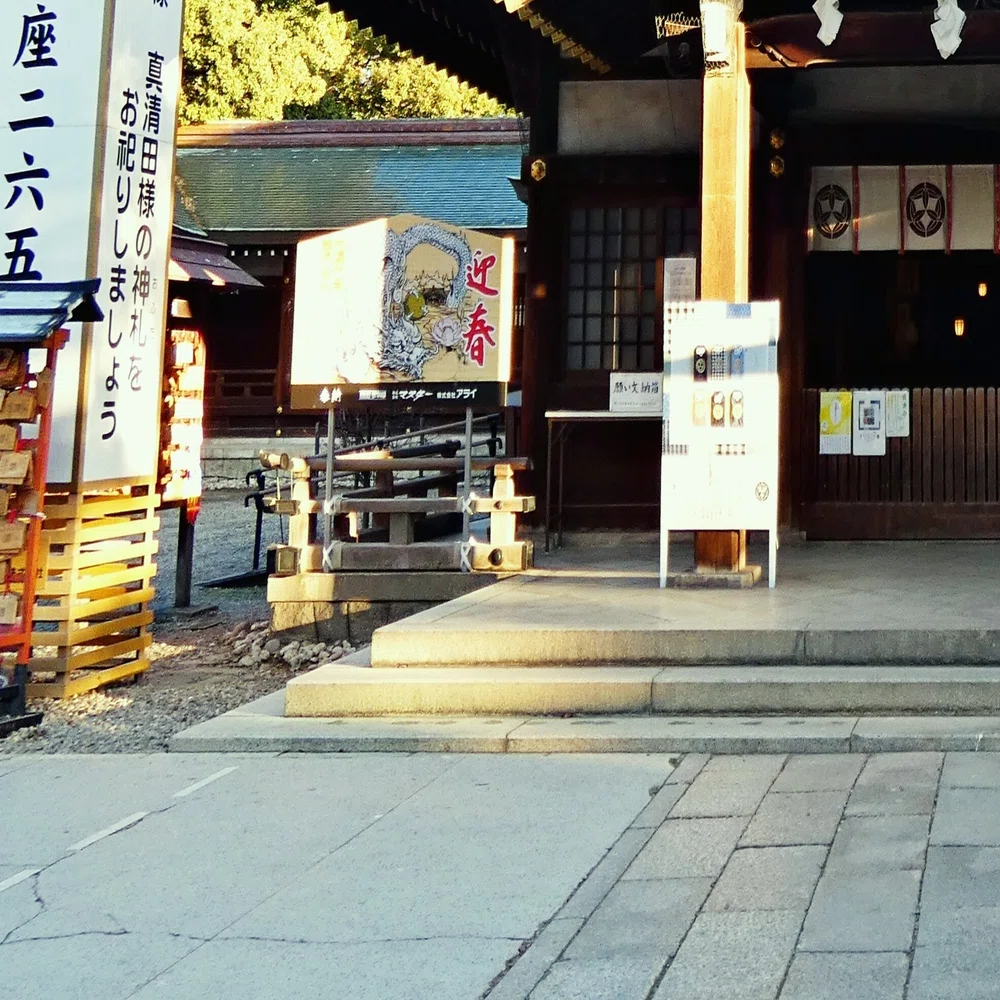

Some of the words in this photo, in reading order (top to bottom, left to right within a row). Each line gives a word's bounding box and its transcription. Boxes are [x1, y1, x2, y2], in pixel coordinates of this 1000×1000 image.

[101, 87, 139, 441] お祀りしましょう
[127, 50, 164, 392] 真清田様の神札を
[462, 250, 499, 367] 迎春
